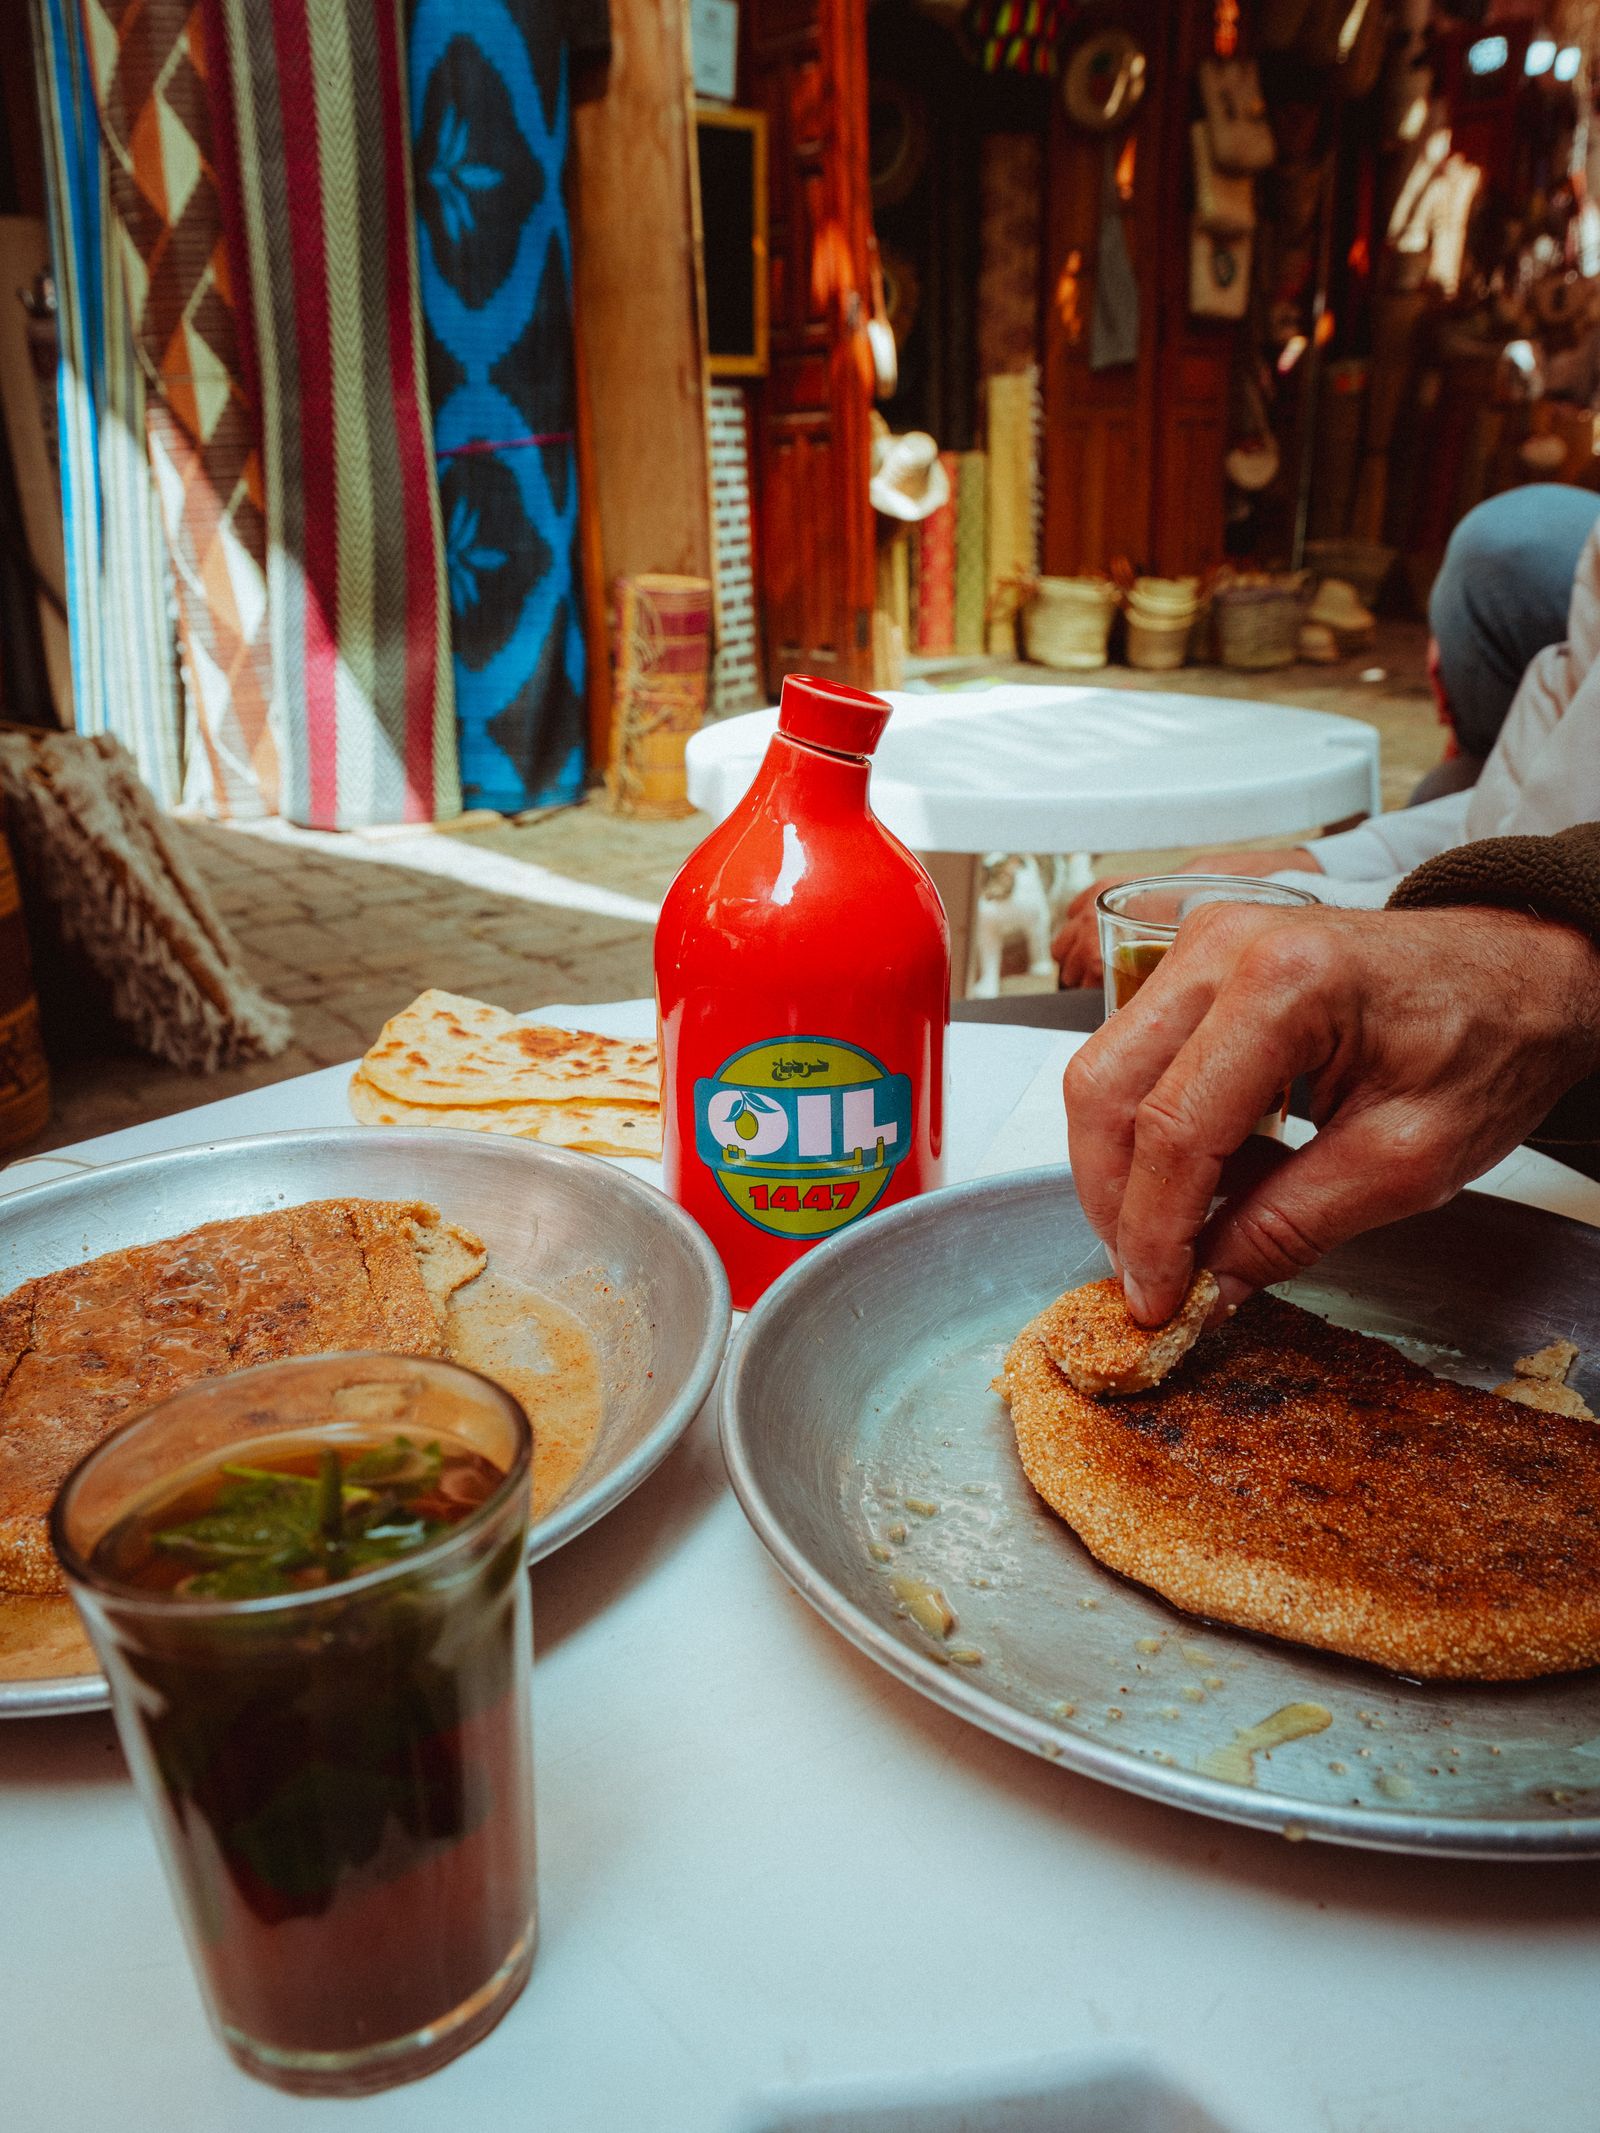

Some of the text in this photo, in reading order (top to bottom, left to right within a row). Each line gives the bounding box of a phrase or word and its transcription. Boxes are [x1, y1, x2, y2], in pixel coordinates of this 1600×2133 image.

[708, 1088, 898, 1157] OIL
[721, 1135, 885, 1172] زيت
[748, 1181, 860, 1212] 1447
